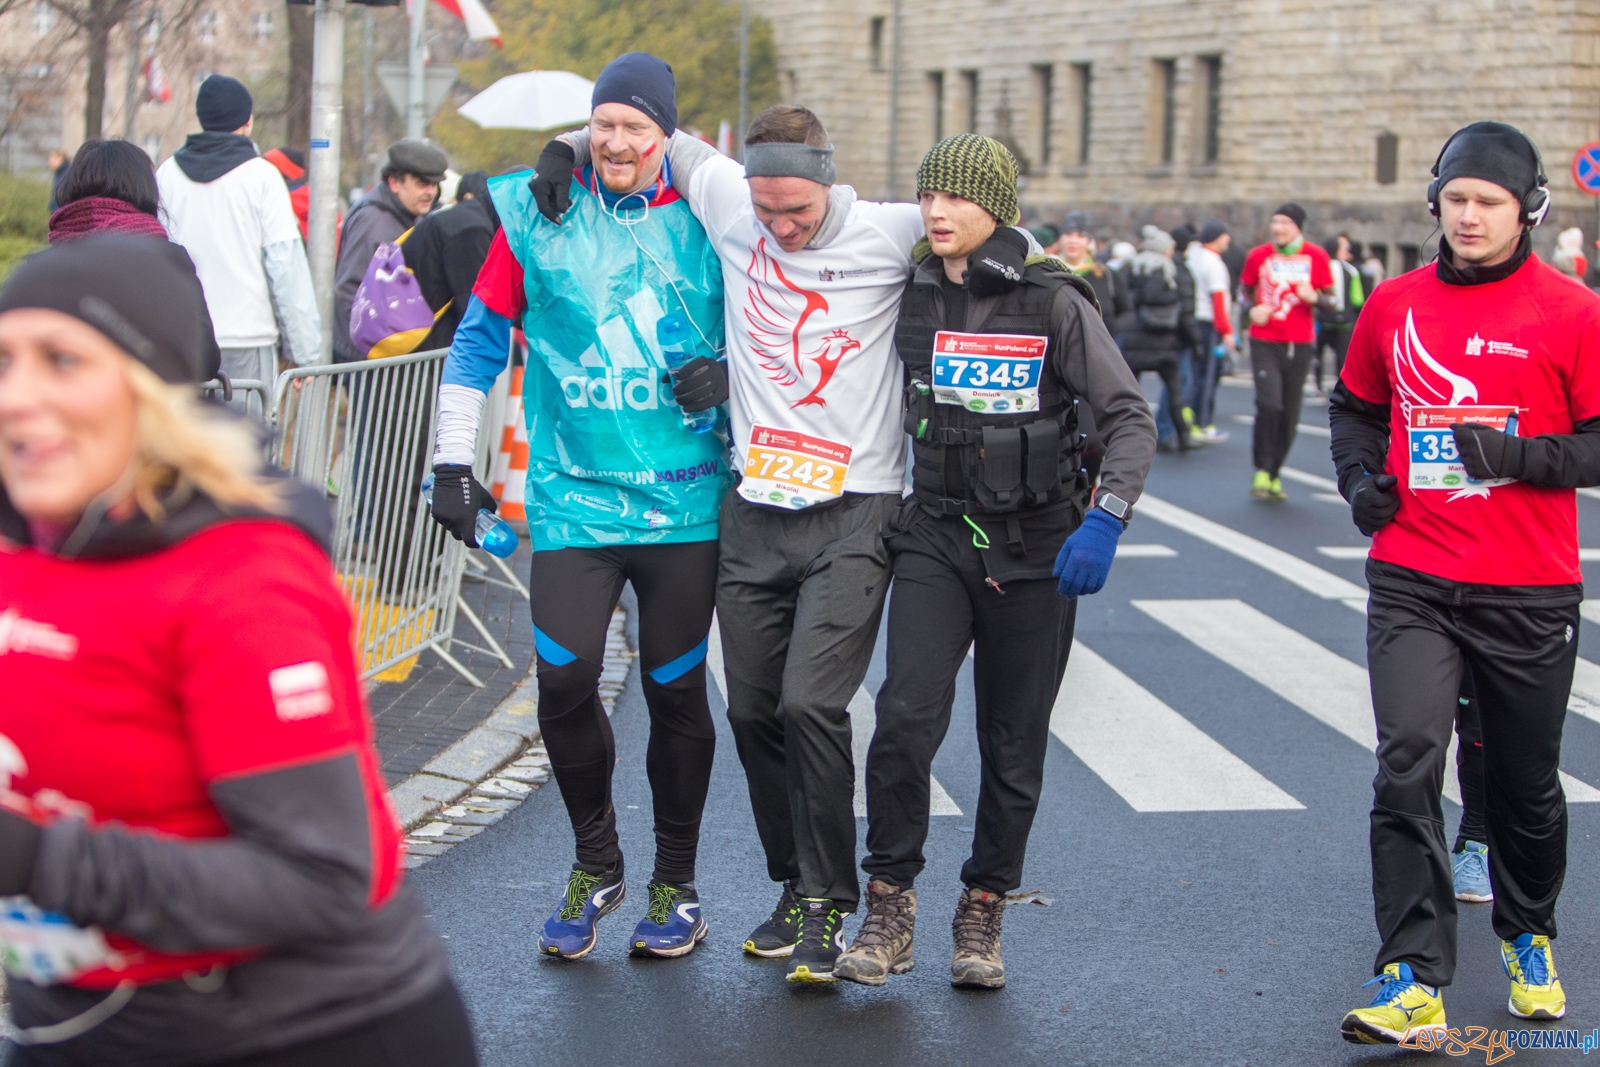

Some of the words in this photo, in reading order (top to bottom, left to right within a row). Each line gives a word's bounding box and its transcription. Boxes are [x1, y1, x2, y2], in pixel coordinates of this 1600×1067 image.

[994, 344, 1039, 354] RunPoland.org
[936, 366, 944, 376] E
[948, 359, 1031, 388] 7345
[560, 366, 680, 411] adid
[972, 390, 1001, 398] Dominik
[1462, 416, 1508, 425] RunPoland.org
[801, 442, 845, 459] RunPoland.org
[1412, 442, 1420, 452] E
[1422, 434, 1459, 460] 35
[747, 457, 756, 467] D
[759, 452, 835, 490] 7242
